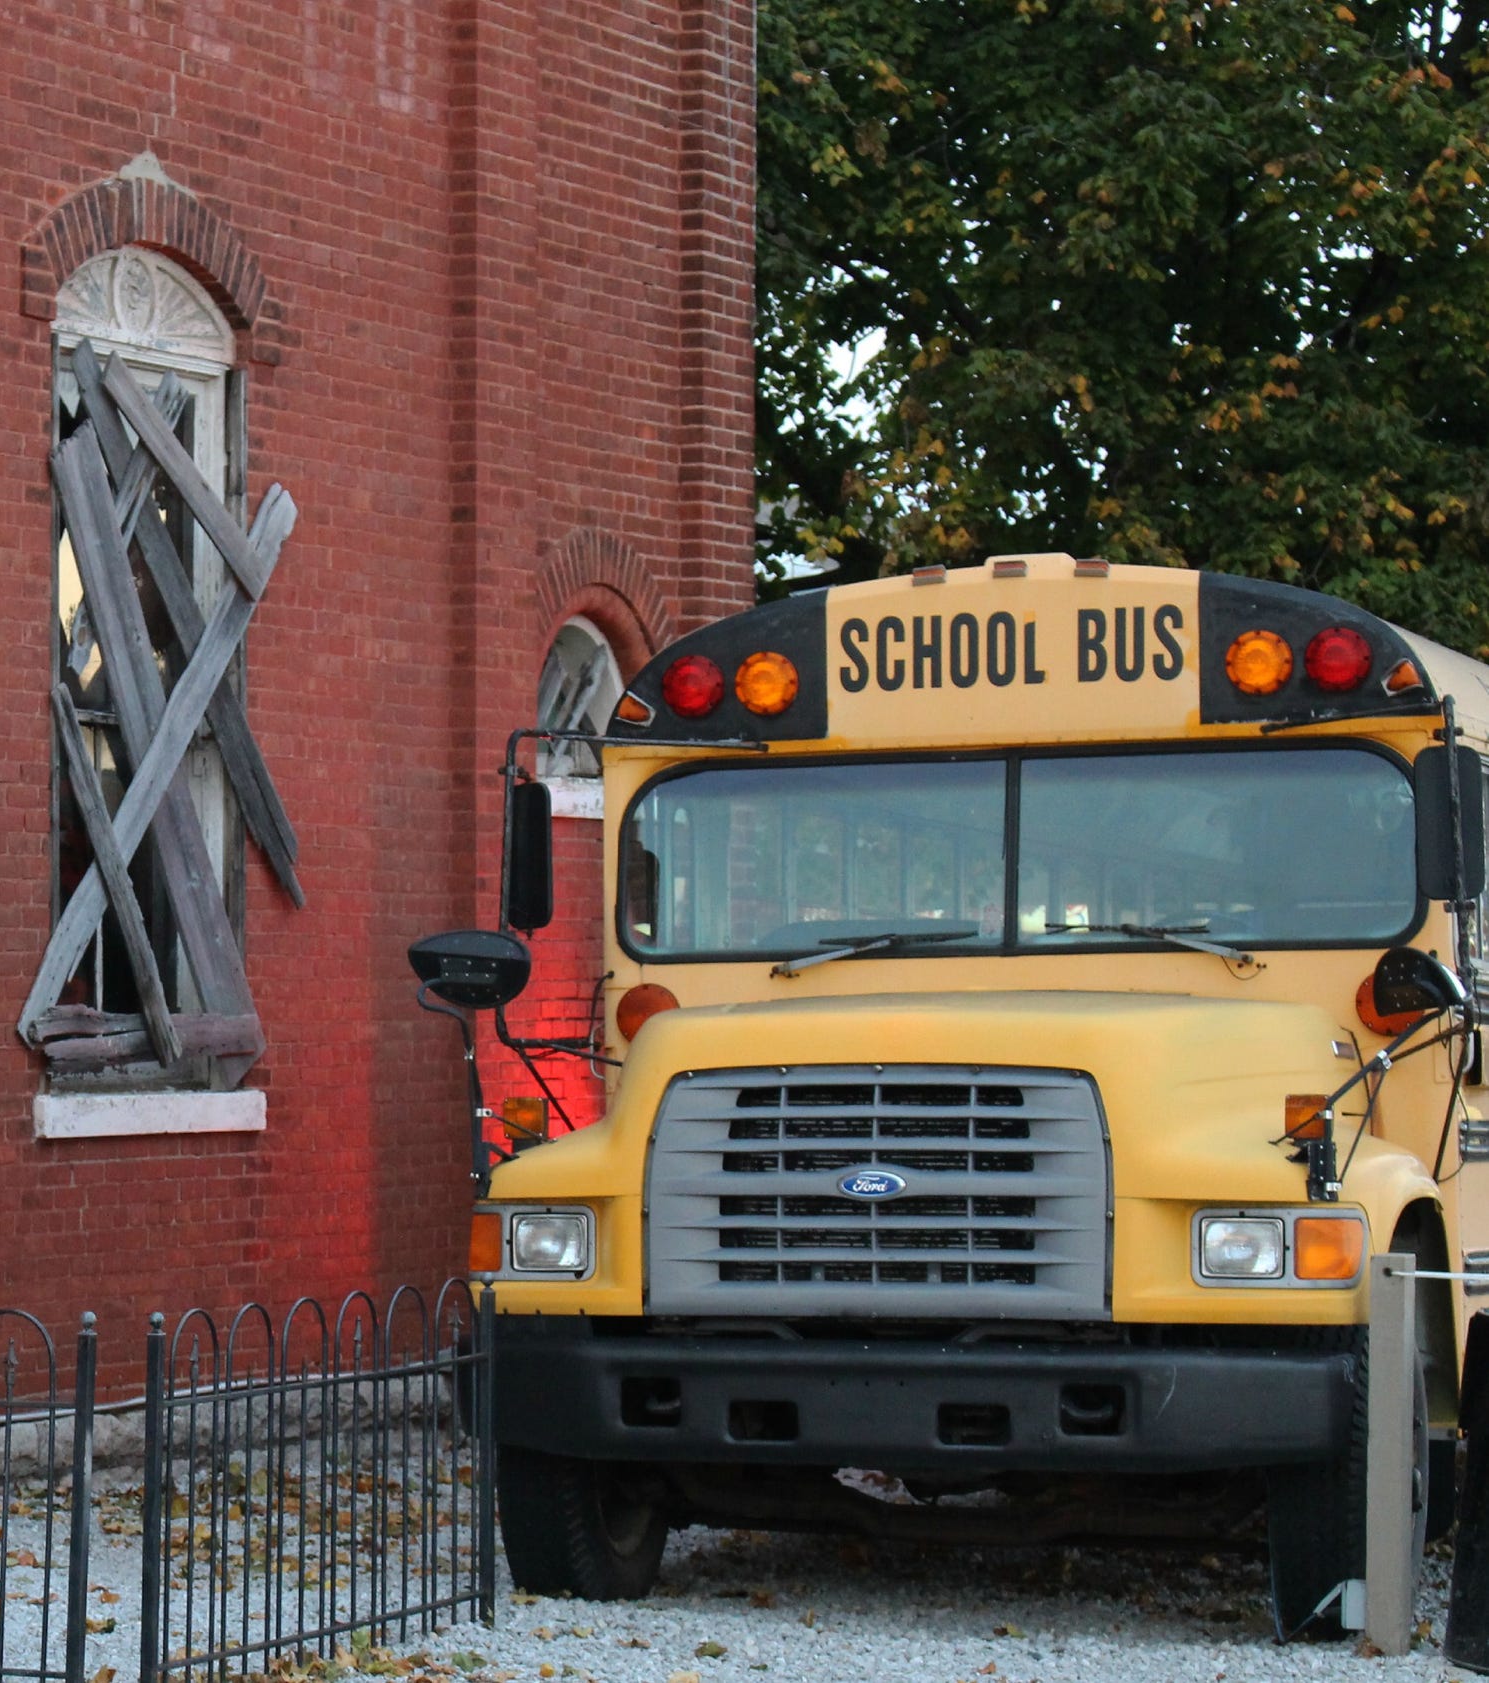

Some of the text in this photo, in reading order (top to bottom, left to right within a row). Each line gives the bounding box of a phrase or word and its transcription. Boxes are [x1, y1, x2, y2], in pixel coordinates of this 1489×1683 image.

[840, 604, 1184, 692] SCHOOL BUS
[852, 1176, 889, 1192] Ford
